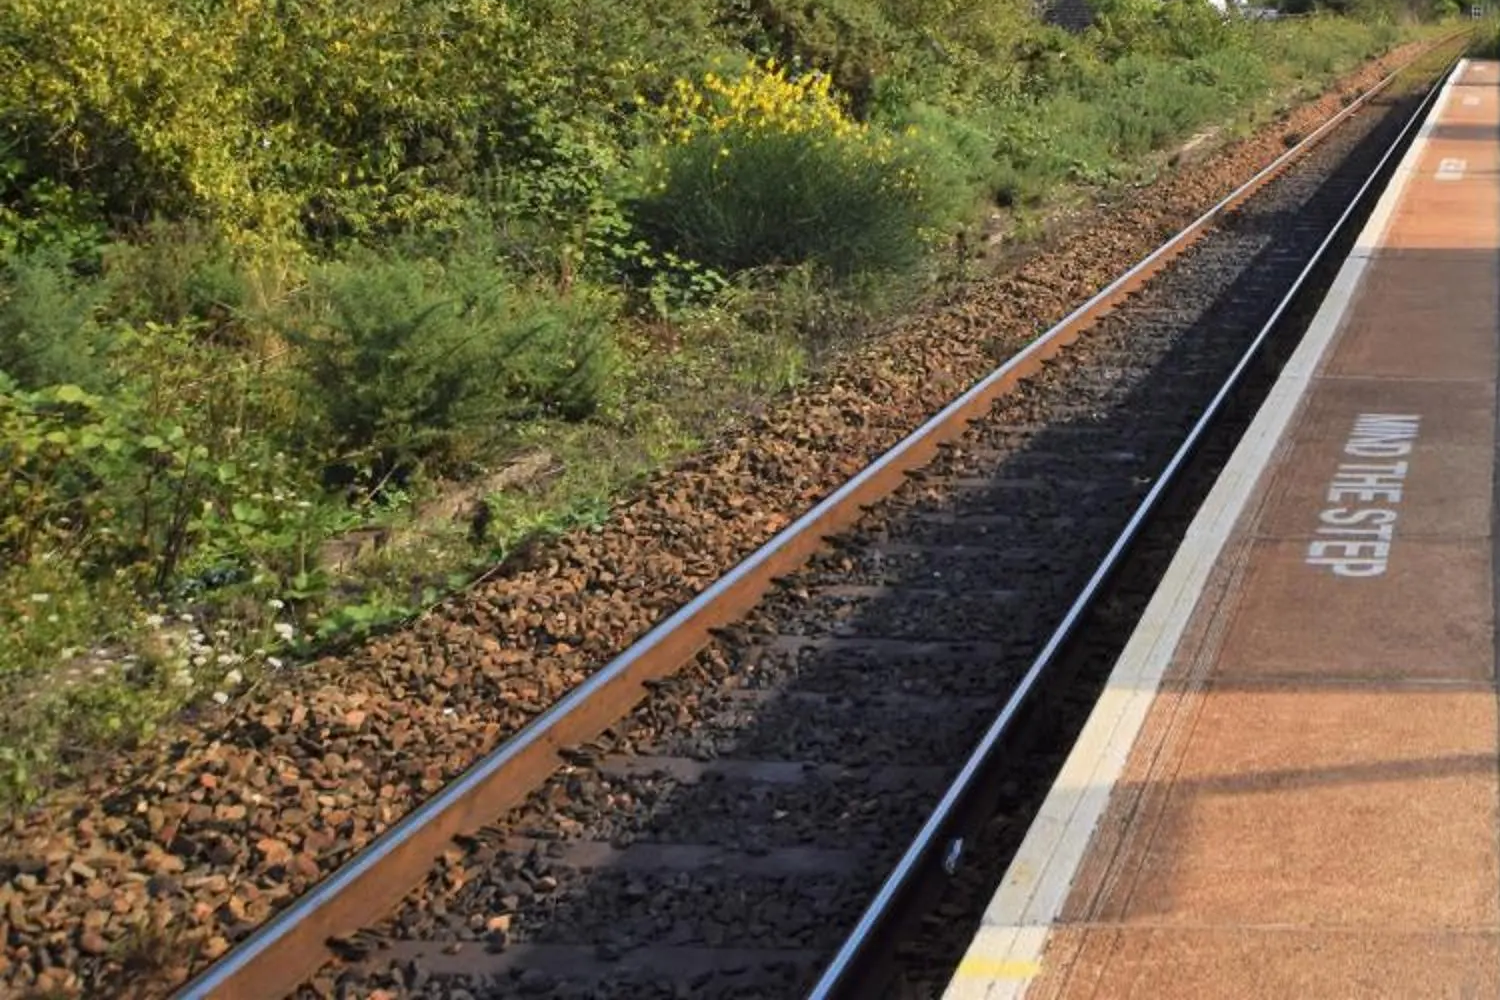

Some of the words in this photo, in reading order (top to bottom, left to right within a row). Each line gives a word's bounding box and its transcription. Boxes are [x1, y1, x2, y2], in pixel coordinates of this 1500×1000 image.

[1344, 413, 1422, 457] MIND
[1328, 461, 1408, 503] THE
[1305, 509, 1397, 577] STEP
